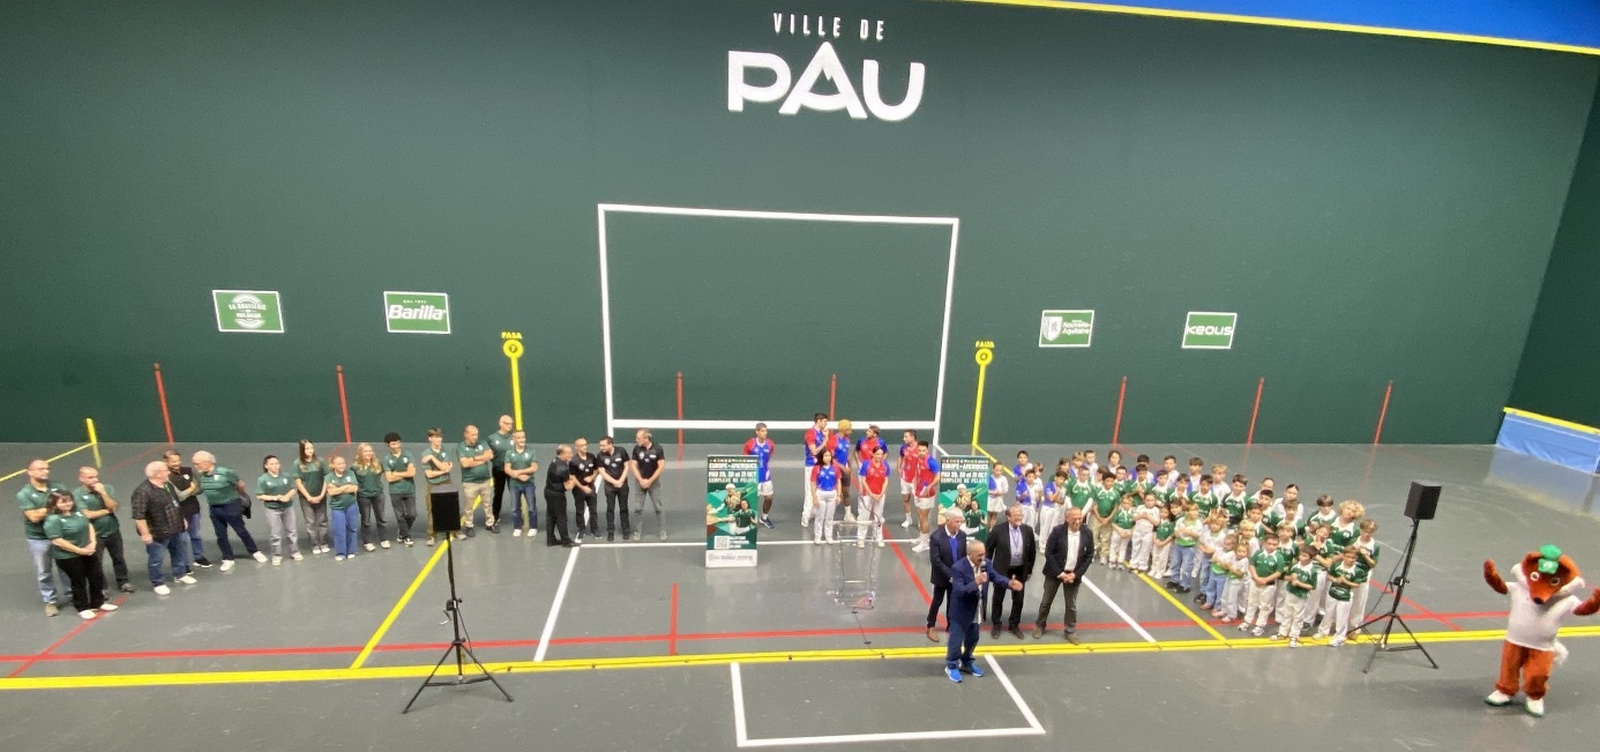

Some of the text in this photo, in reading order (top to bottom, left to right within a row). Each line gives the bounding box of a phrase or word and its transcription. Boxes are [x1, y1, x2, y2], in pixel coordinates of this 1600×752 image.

[773, 12, 884, 40] VILLE DE
[728, 41, 926, 121] PAU
[388, 304, 443, 320] Barilla
[501, 331, 522, 339] PASA
